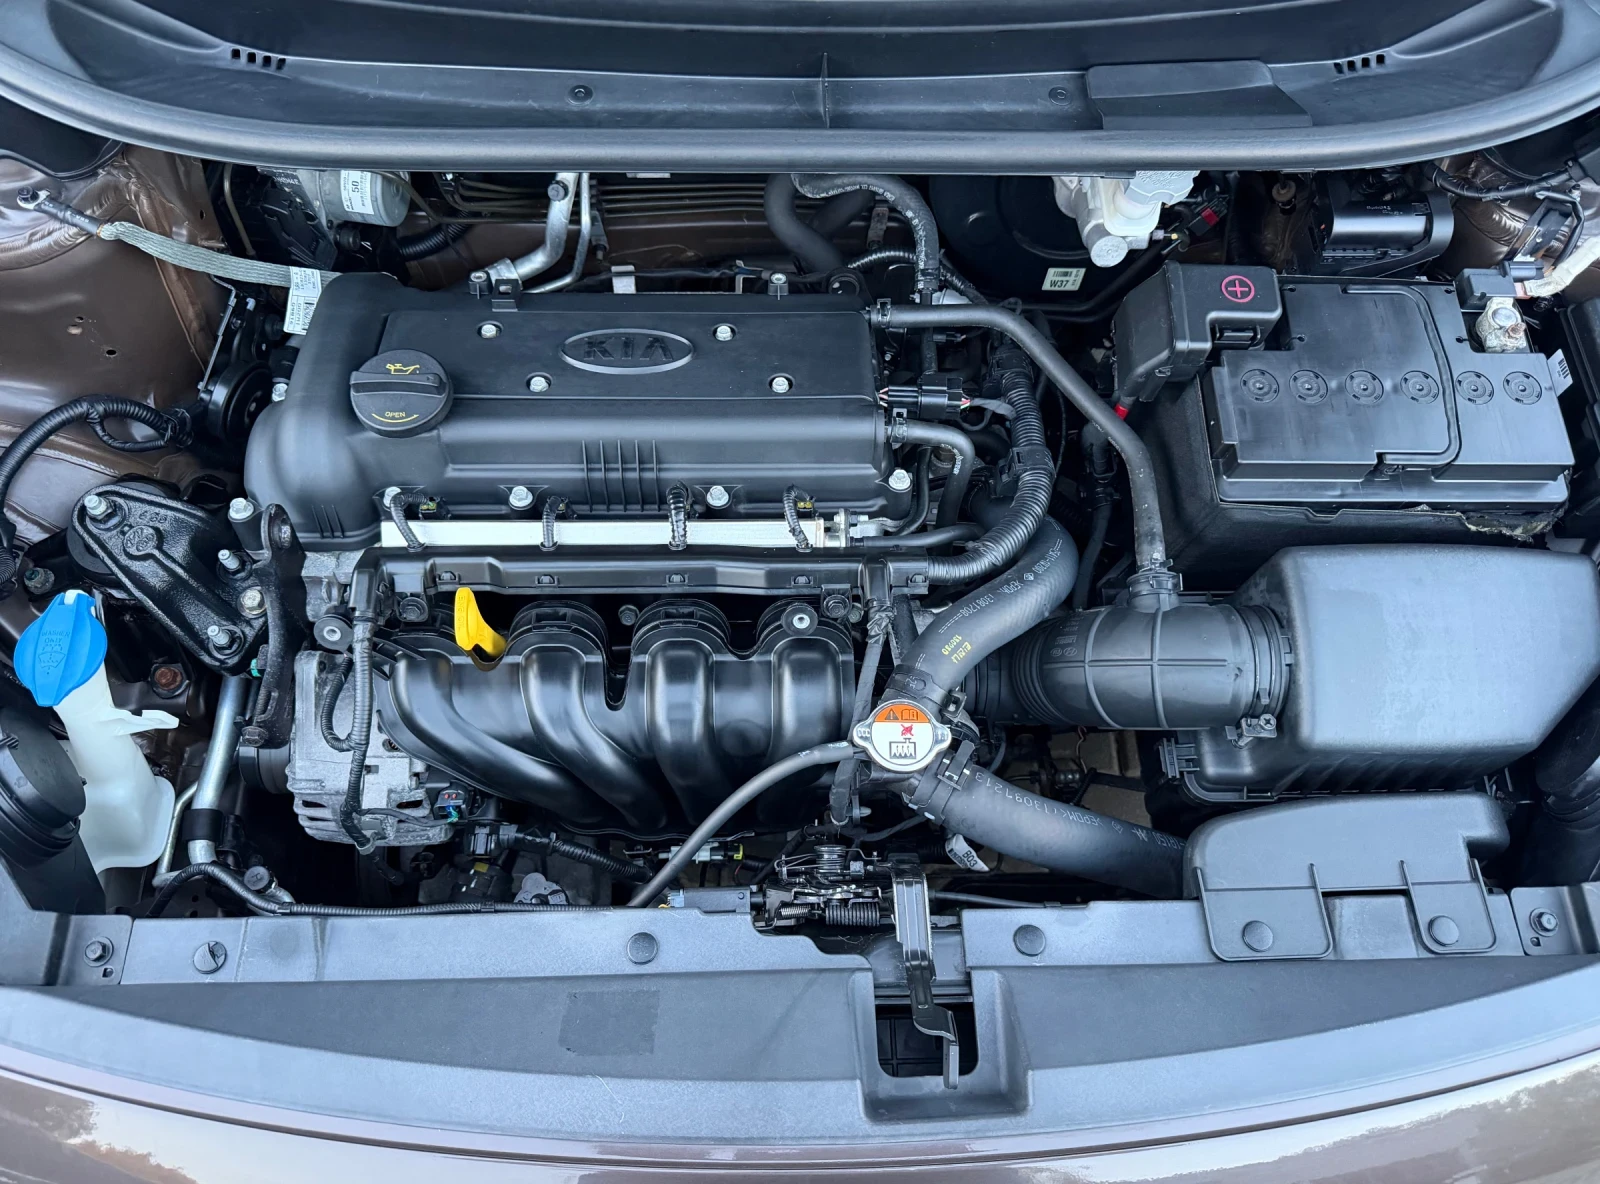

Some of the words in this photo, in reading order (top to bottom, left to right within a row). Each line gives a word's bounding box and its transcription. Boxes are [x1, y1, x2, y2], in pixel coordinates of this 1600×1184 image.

[351, 181, 359, 192] 50
[1050, 280, 1069, 288] W37
[583, 337, 674, 360] KIA
[962, 850, 978, 868] B03
